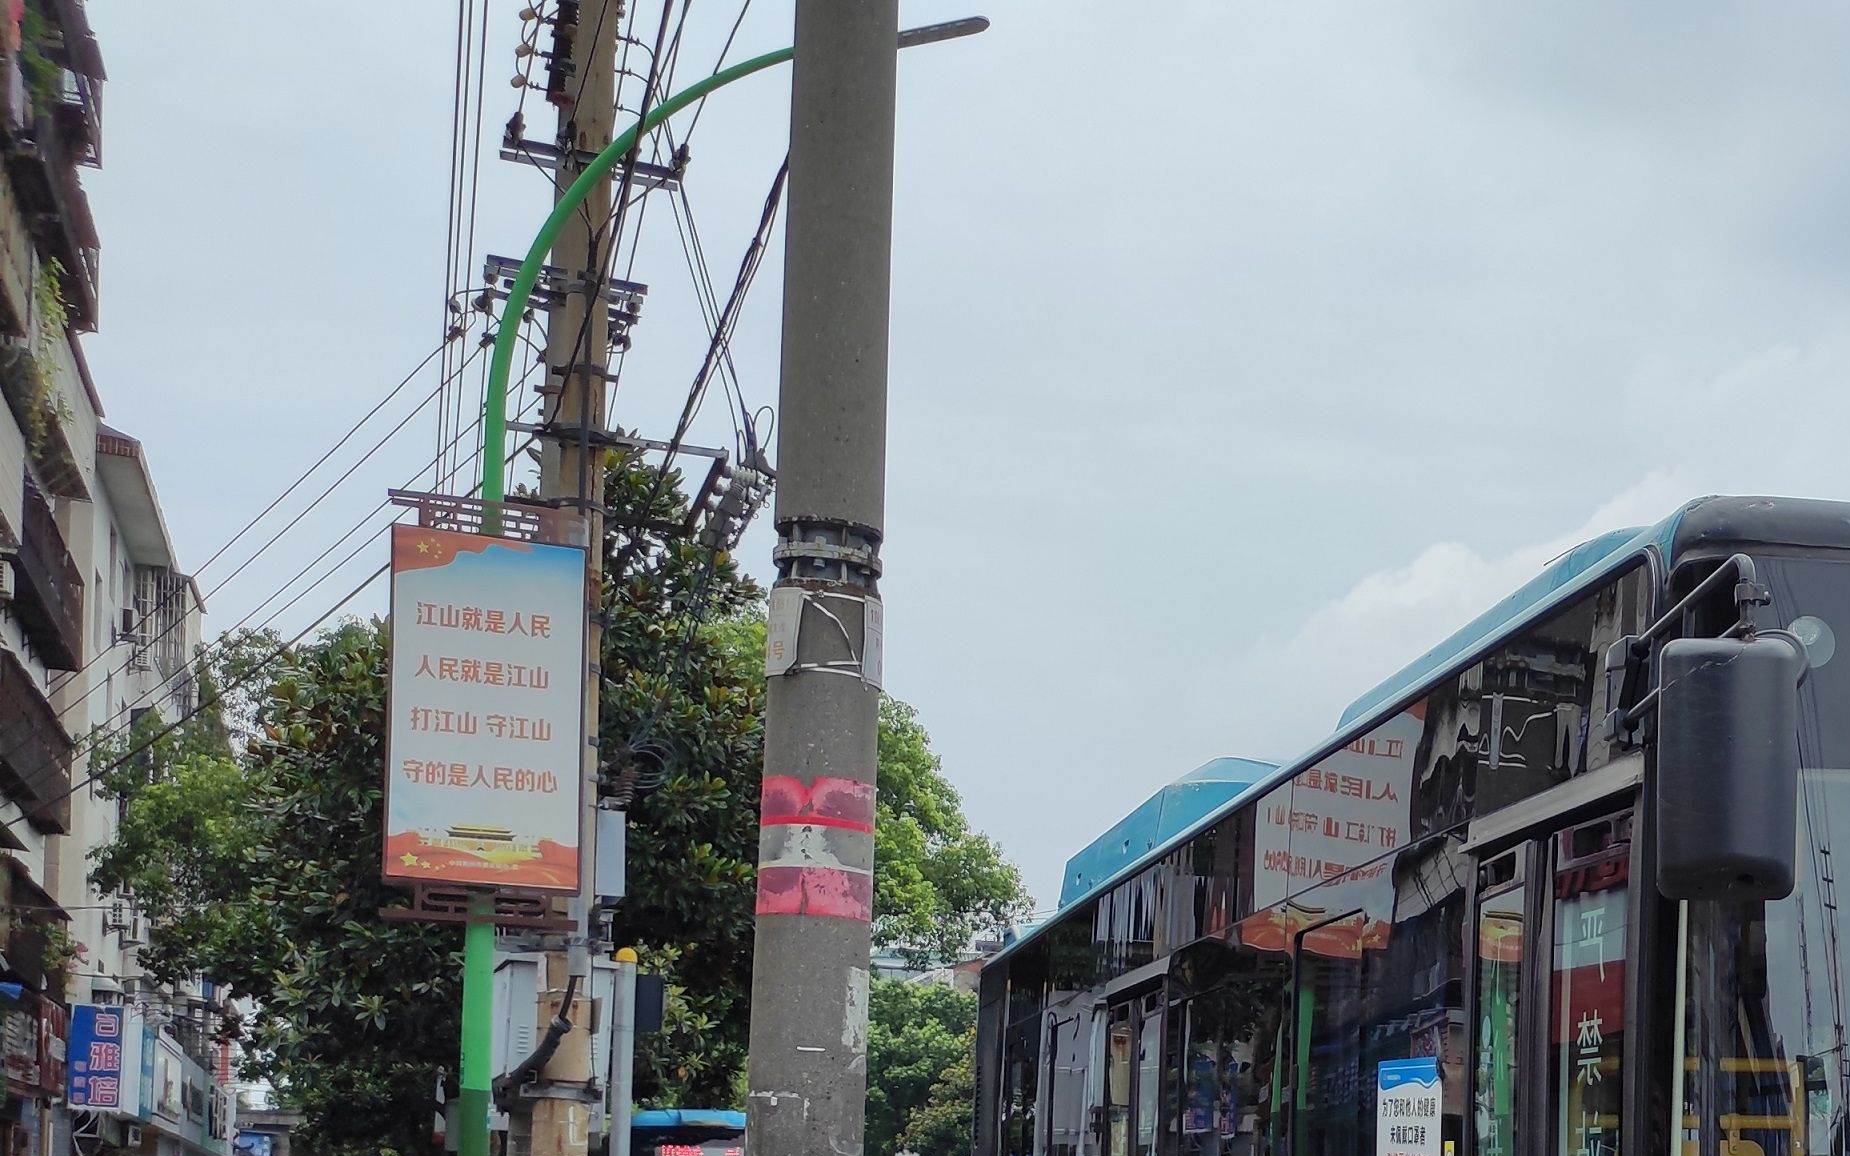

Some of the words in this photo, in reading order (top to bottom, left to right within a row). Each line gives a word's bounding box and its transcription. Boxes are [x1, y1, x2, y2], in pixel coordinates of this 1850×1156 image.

[415, 601, 551, 639] 江山就是人民
[415, 654, 550, 690] 人民就是江山
[410, 706, 478, 736] 打江山
[486, 713, 552, 742] 守江山
[403, 759, 558, 794] 守的是人民的心
[1381, 1098, 1436, 1118] 为了您和他人的健康
